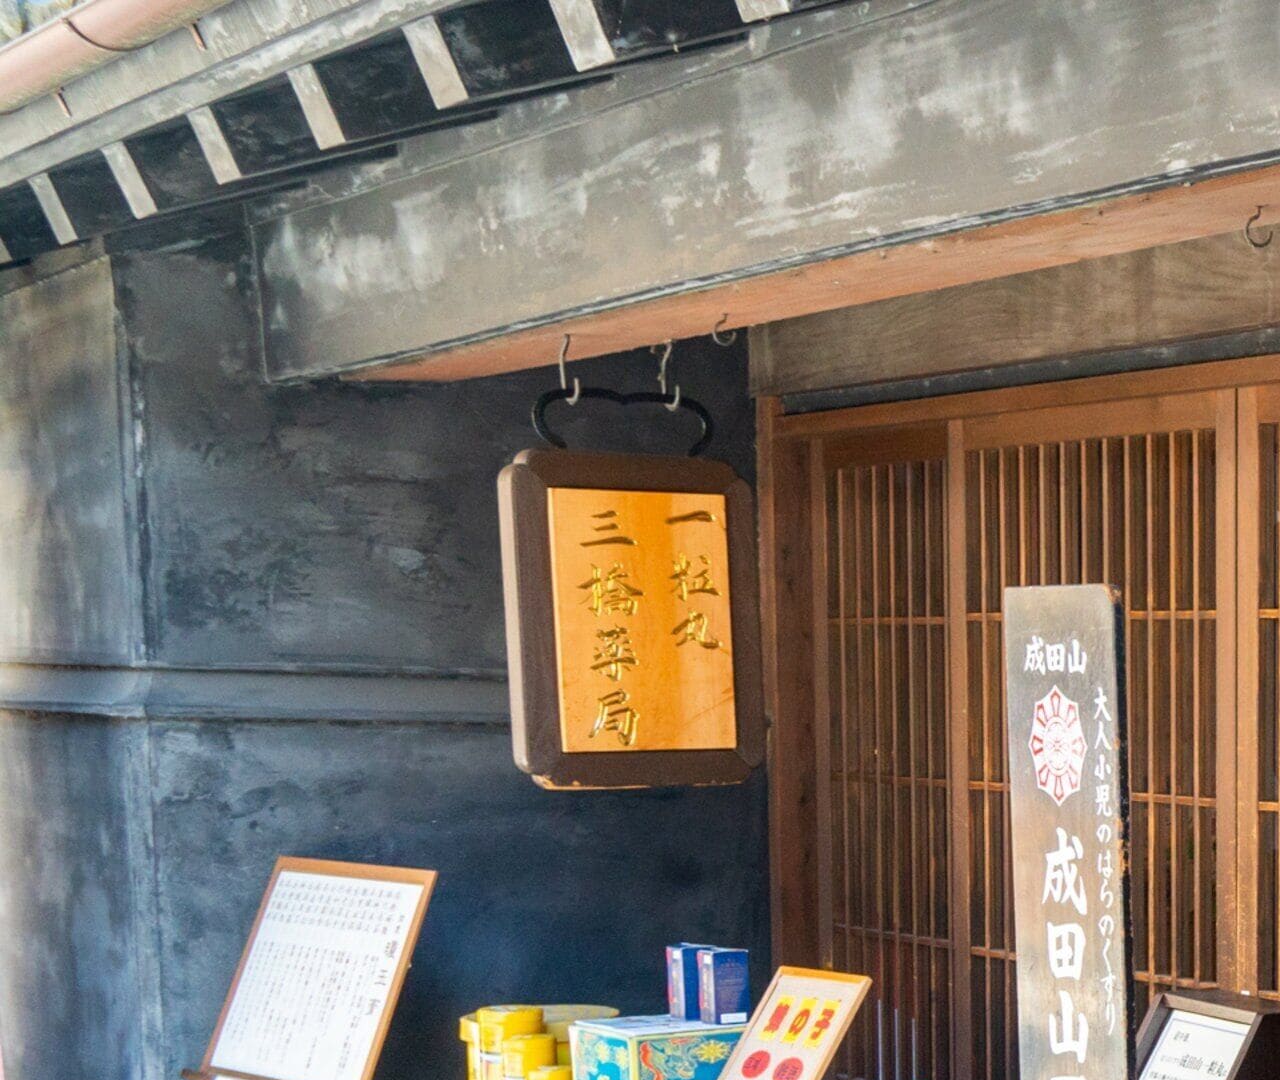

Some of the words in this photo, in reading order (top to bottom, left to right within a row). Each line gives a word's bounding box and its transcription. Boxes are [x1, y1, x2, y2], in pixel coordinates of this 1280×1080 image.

[578, 509, 645, 747] 三橋薬局
[664, 509, 724, 650] 一粒丸
[1024, 635, 1088, 676] 成田山
